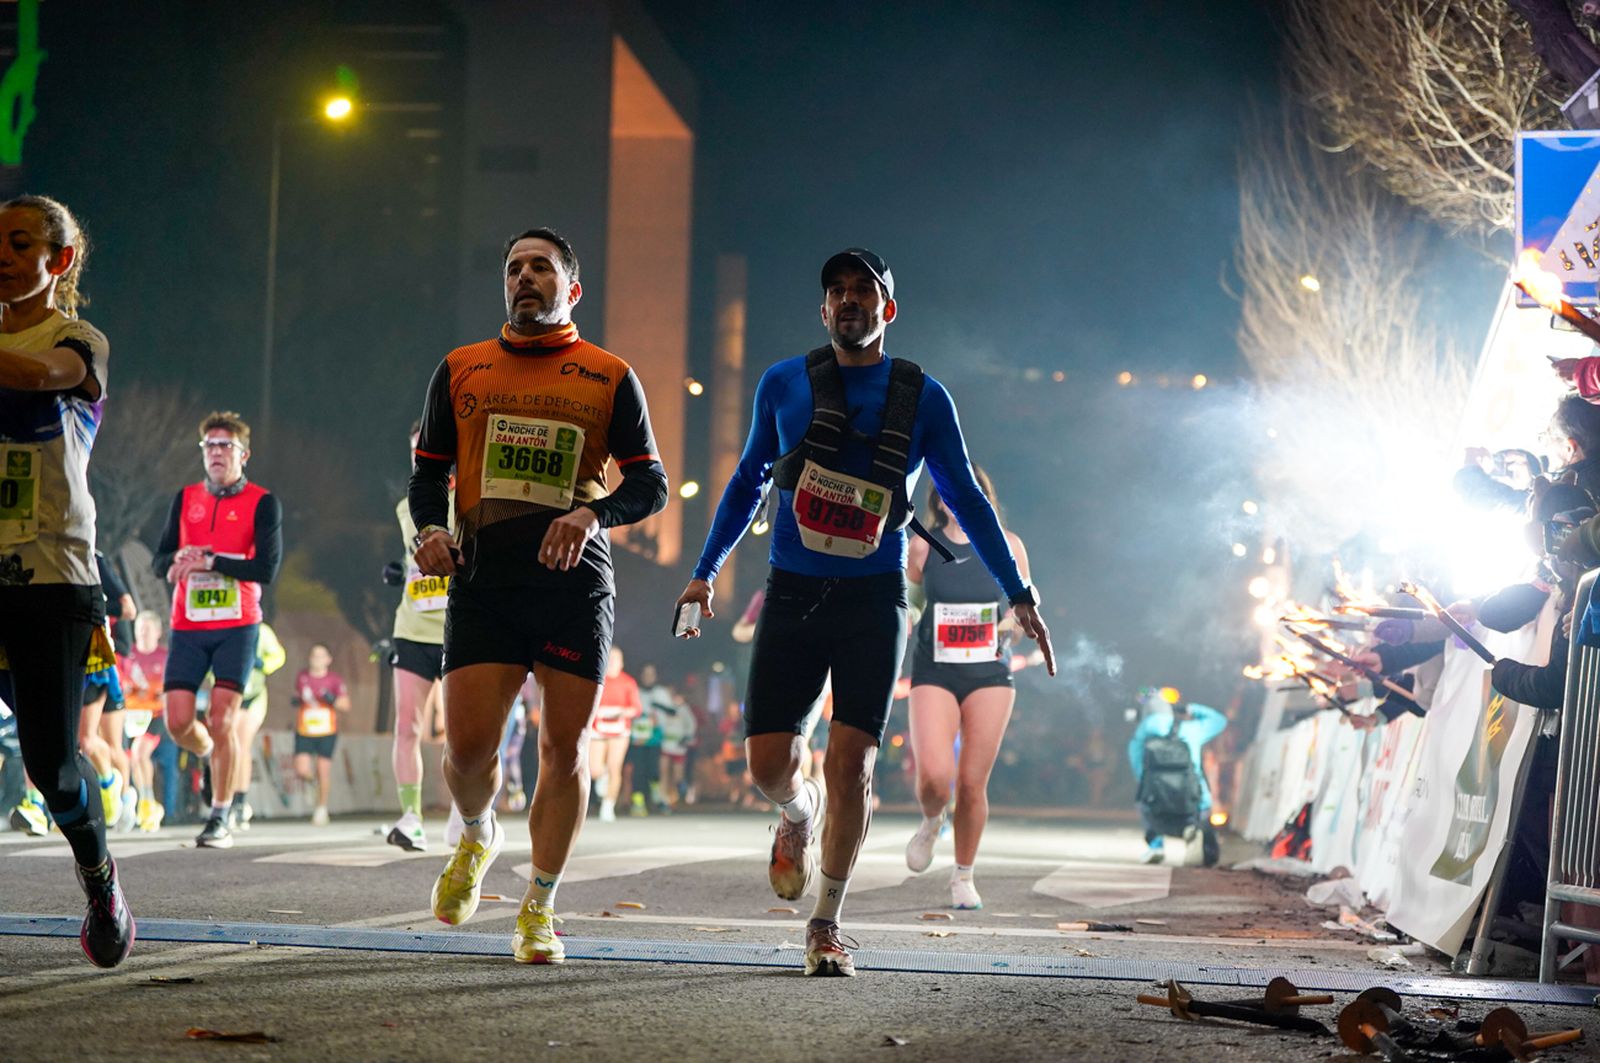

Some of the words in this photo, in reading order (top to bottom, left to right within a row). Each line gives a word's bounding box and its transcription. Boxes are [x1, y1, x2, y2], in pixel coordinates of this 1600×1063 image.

[483, 393, 518, 406] ÁREA
[523, 395, 541, 406] DE
[508, 425, 536, 435] NOCHE
[537, 427, 549, 437] DE
[495, 434, 514, 444] SAN
[516, 435, 547, 448] ANTÓN
[498, 445, 564, 477] 3668
[805, 482, 823, 496] SAN
[817, 477, 844, 492] NOCHE
[845, 484, 856, 495] DE
[198, 589, 228, 604] 8747
